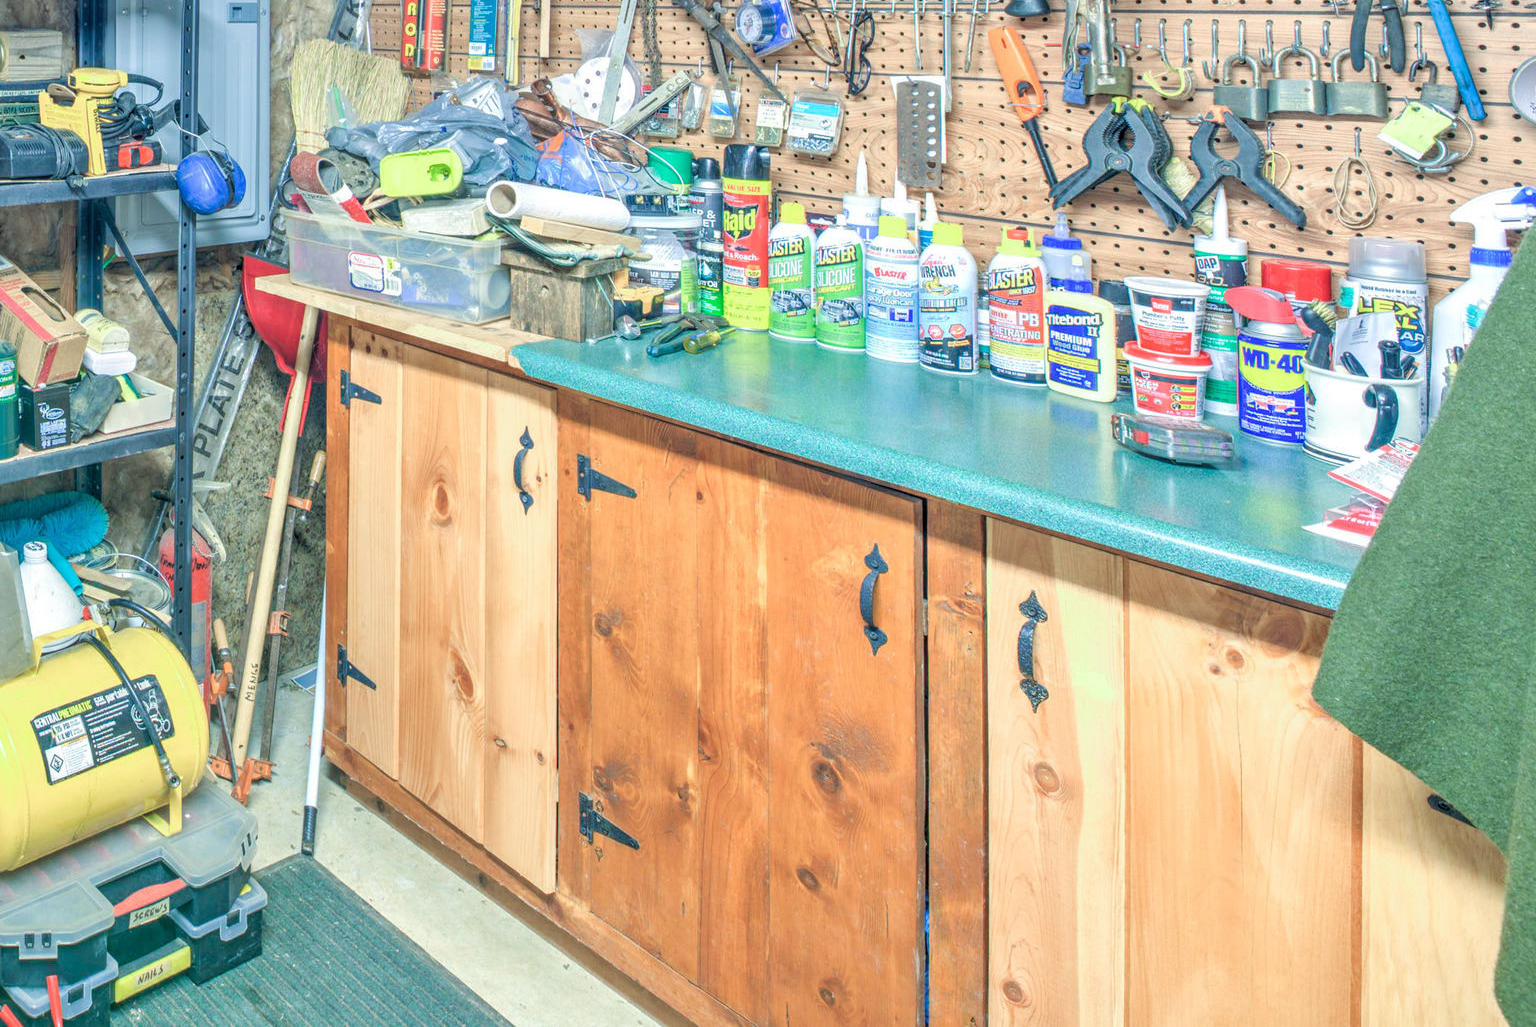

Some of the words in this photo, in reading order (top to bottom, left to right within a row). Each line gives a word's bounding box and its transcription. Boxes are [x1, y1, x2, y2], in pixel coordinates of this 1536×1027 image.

[747, 185, 761, 193] SIZE
[707, 210, 716, 220] &
[723, 209, 756, 231] Raid
[734, 252, 757, 261] Roach
[1197, 256, 1217, 270] DAP
[920, 264, 956, 278] WRENCH
[892, 287, 914, 298] Door
[1375, 285, 1395, 294] Rubber
[1358, 296, 1419, 320] LEX
[1018, 312, 1040, 327] PB
[1046, 312, 1101, 326] Titebond
[1050, 329, 1092, 347] PREMIUM
[1052, 339, 1071, 350] Wood
[1071, 342, 1091, 354] Glue
[1242, 345, 1304, 374] WD-40
[193, 353, 245, 460] PLATE
[137, 679, 151, 691] tank
[246, 662, 259, 703] MENGE
[132, 903, 168, 923] SCREWS
[137, 964, 164, 986] NAILS
